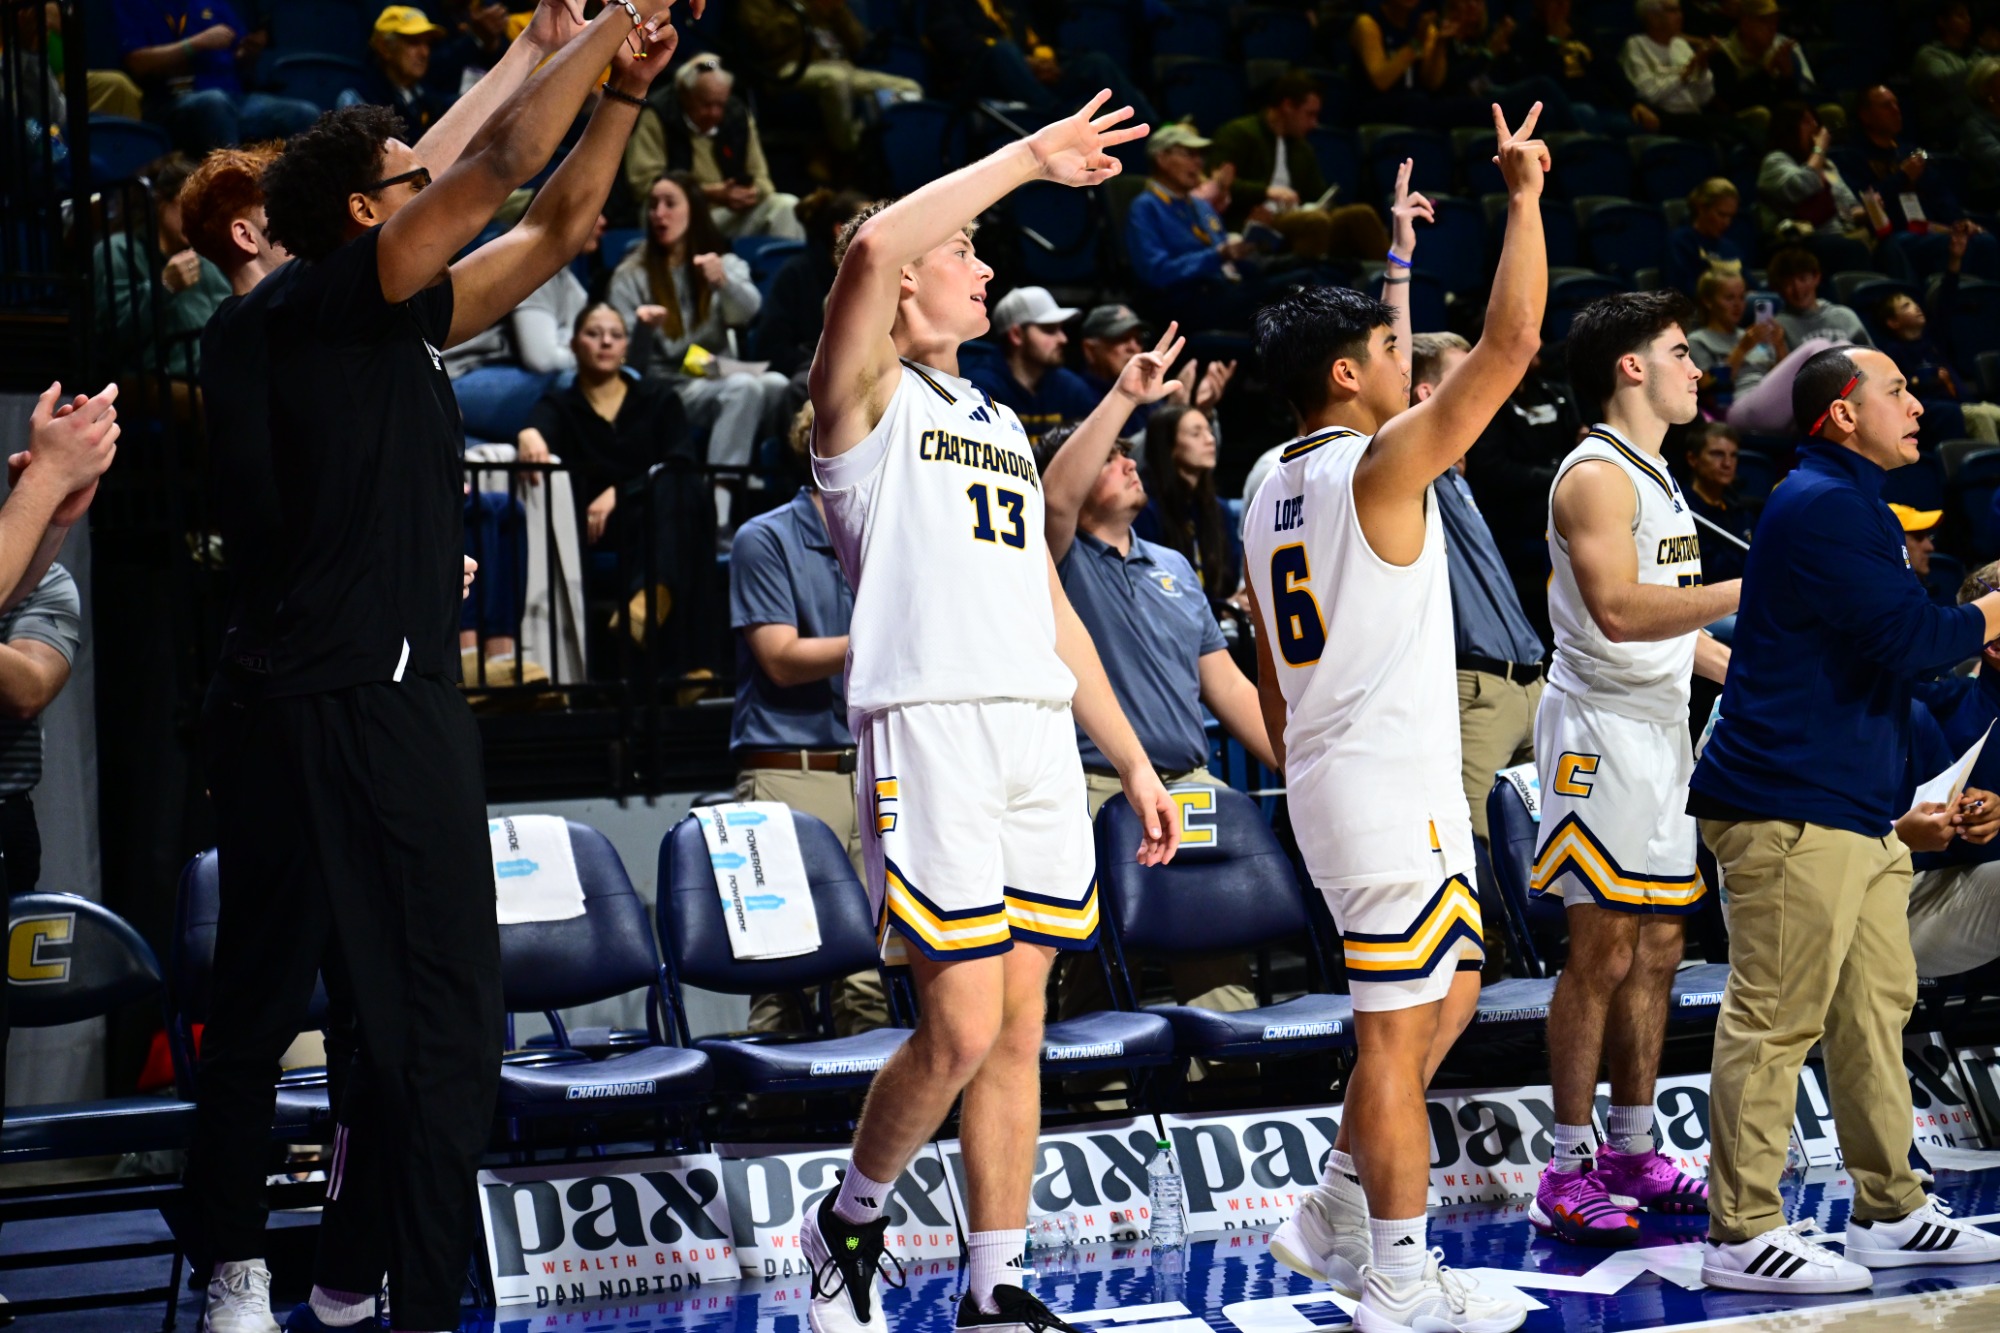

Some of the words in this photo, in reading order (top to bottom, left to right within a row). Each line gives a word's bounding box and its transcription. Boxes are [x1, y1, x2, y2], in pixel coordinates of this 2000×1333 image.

[919, 429, 1040, 495] CHATTANOOG
[965, 482, 1026, 550] 13
[1274, 494, 1304, 532] LOPE
[1270, 541, 1328, 668] 6
[1553, 751, 1601, 799] C
[1510, 771, 1537, 811] POWERAD
[745, 828, 766, 888] POWERADE
[1682, 993, 1724, 1006] CHATTAN
[1480, 1006, 1550, 1023] CHATTANOOGA
[1265, 1022, 1340, 1040] CHATTANOOGA
[1048, 1042, 1121, 1060] CHATTANOOGA
[813, 1059, 885, 1076] CHATTANOOG
[568, 1081, 653, 1100] CHATTANOOGA
[1916, 1111, 1972, 1128] GROUP
[1443, 1171, 1524, 1187] WEALTH
[1227, 1194, 1295, 1211] WEALT
[484, 1168, 729, 1278] pax
[1029, 1214, 1095, 1234] EALTH
[1109, 1206, 1149, 1224] GRO
[542, 1254, 638, 1274] WEALTH
[655, 1246, 733, 1266] GROUP
[536, 1281, 586, 1308] DAN
